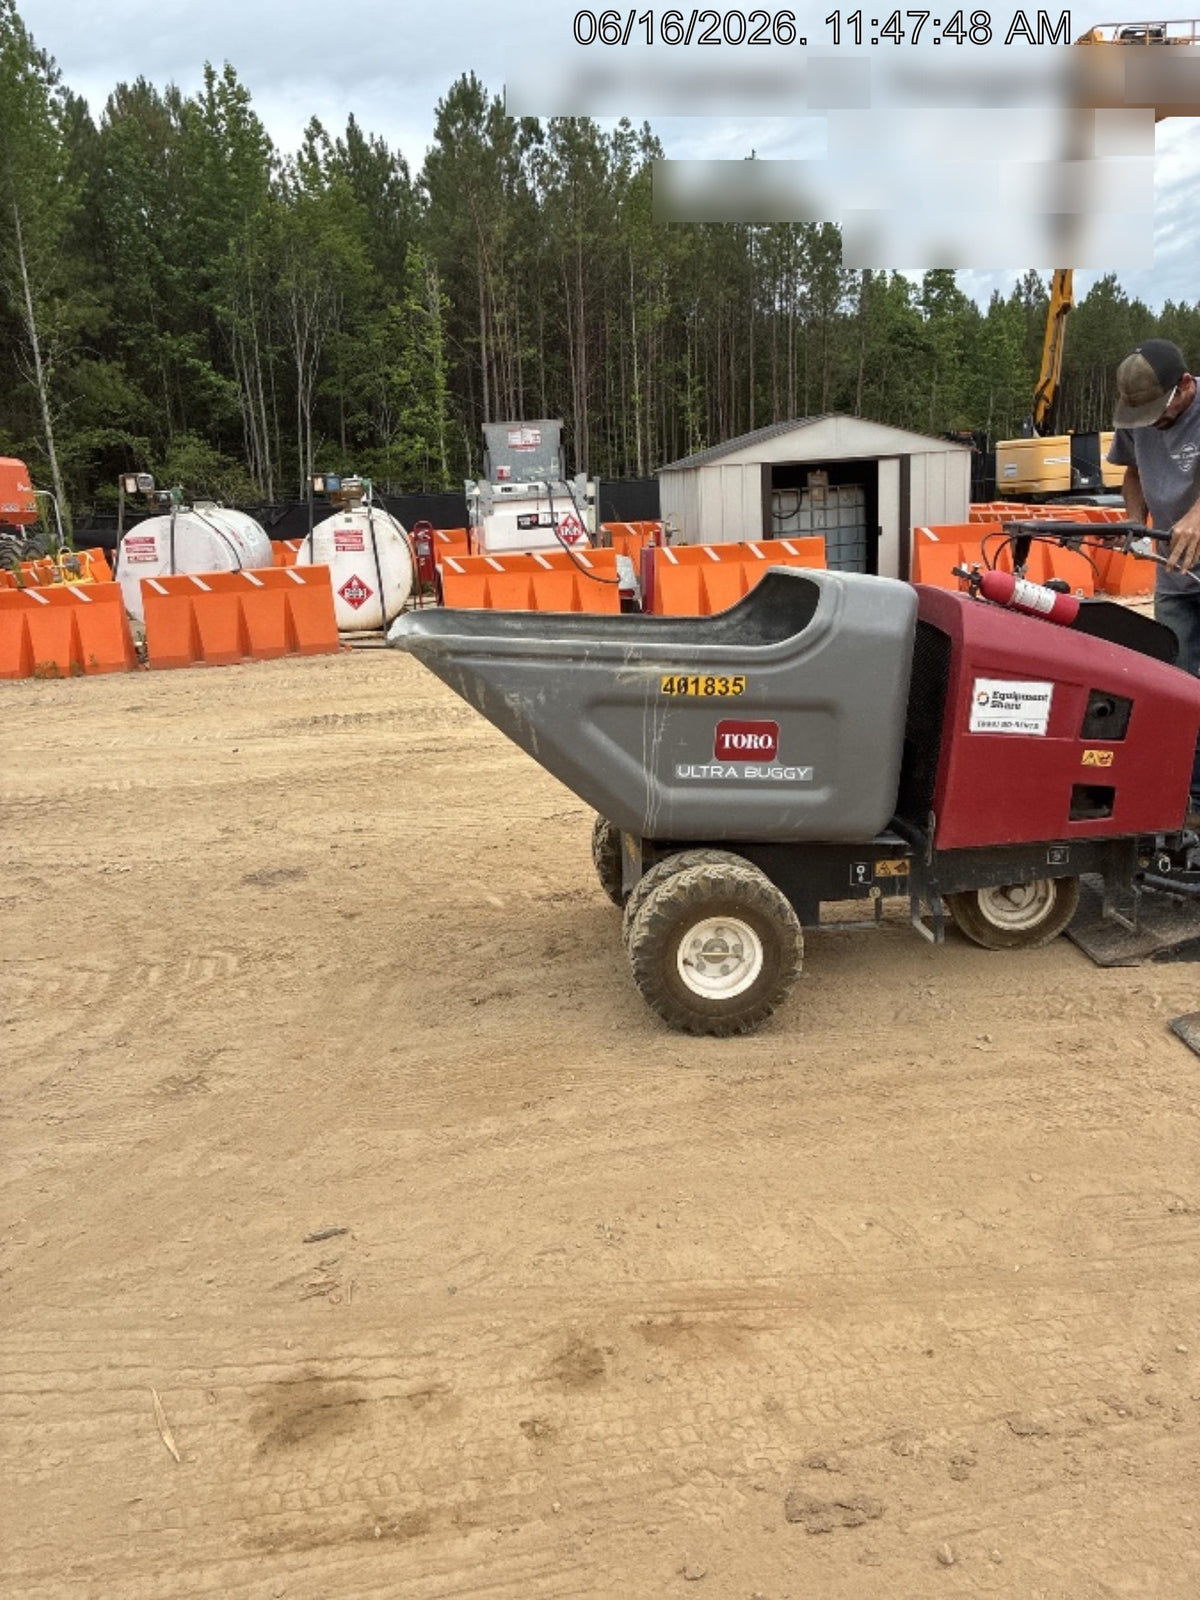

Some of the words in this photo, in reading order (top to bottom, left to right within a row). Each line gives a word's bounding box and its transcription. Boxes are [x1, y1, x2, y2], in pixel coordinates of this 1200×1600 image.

[662, 677, 744, 695] 401835
[992, 691, 1048, 702] Equipment
[721, 733, 774, 750] TORO
[678, 765, 739, 778] ULTRA
[744, 766, 809, 780] BUGGY
